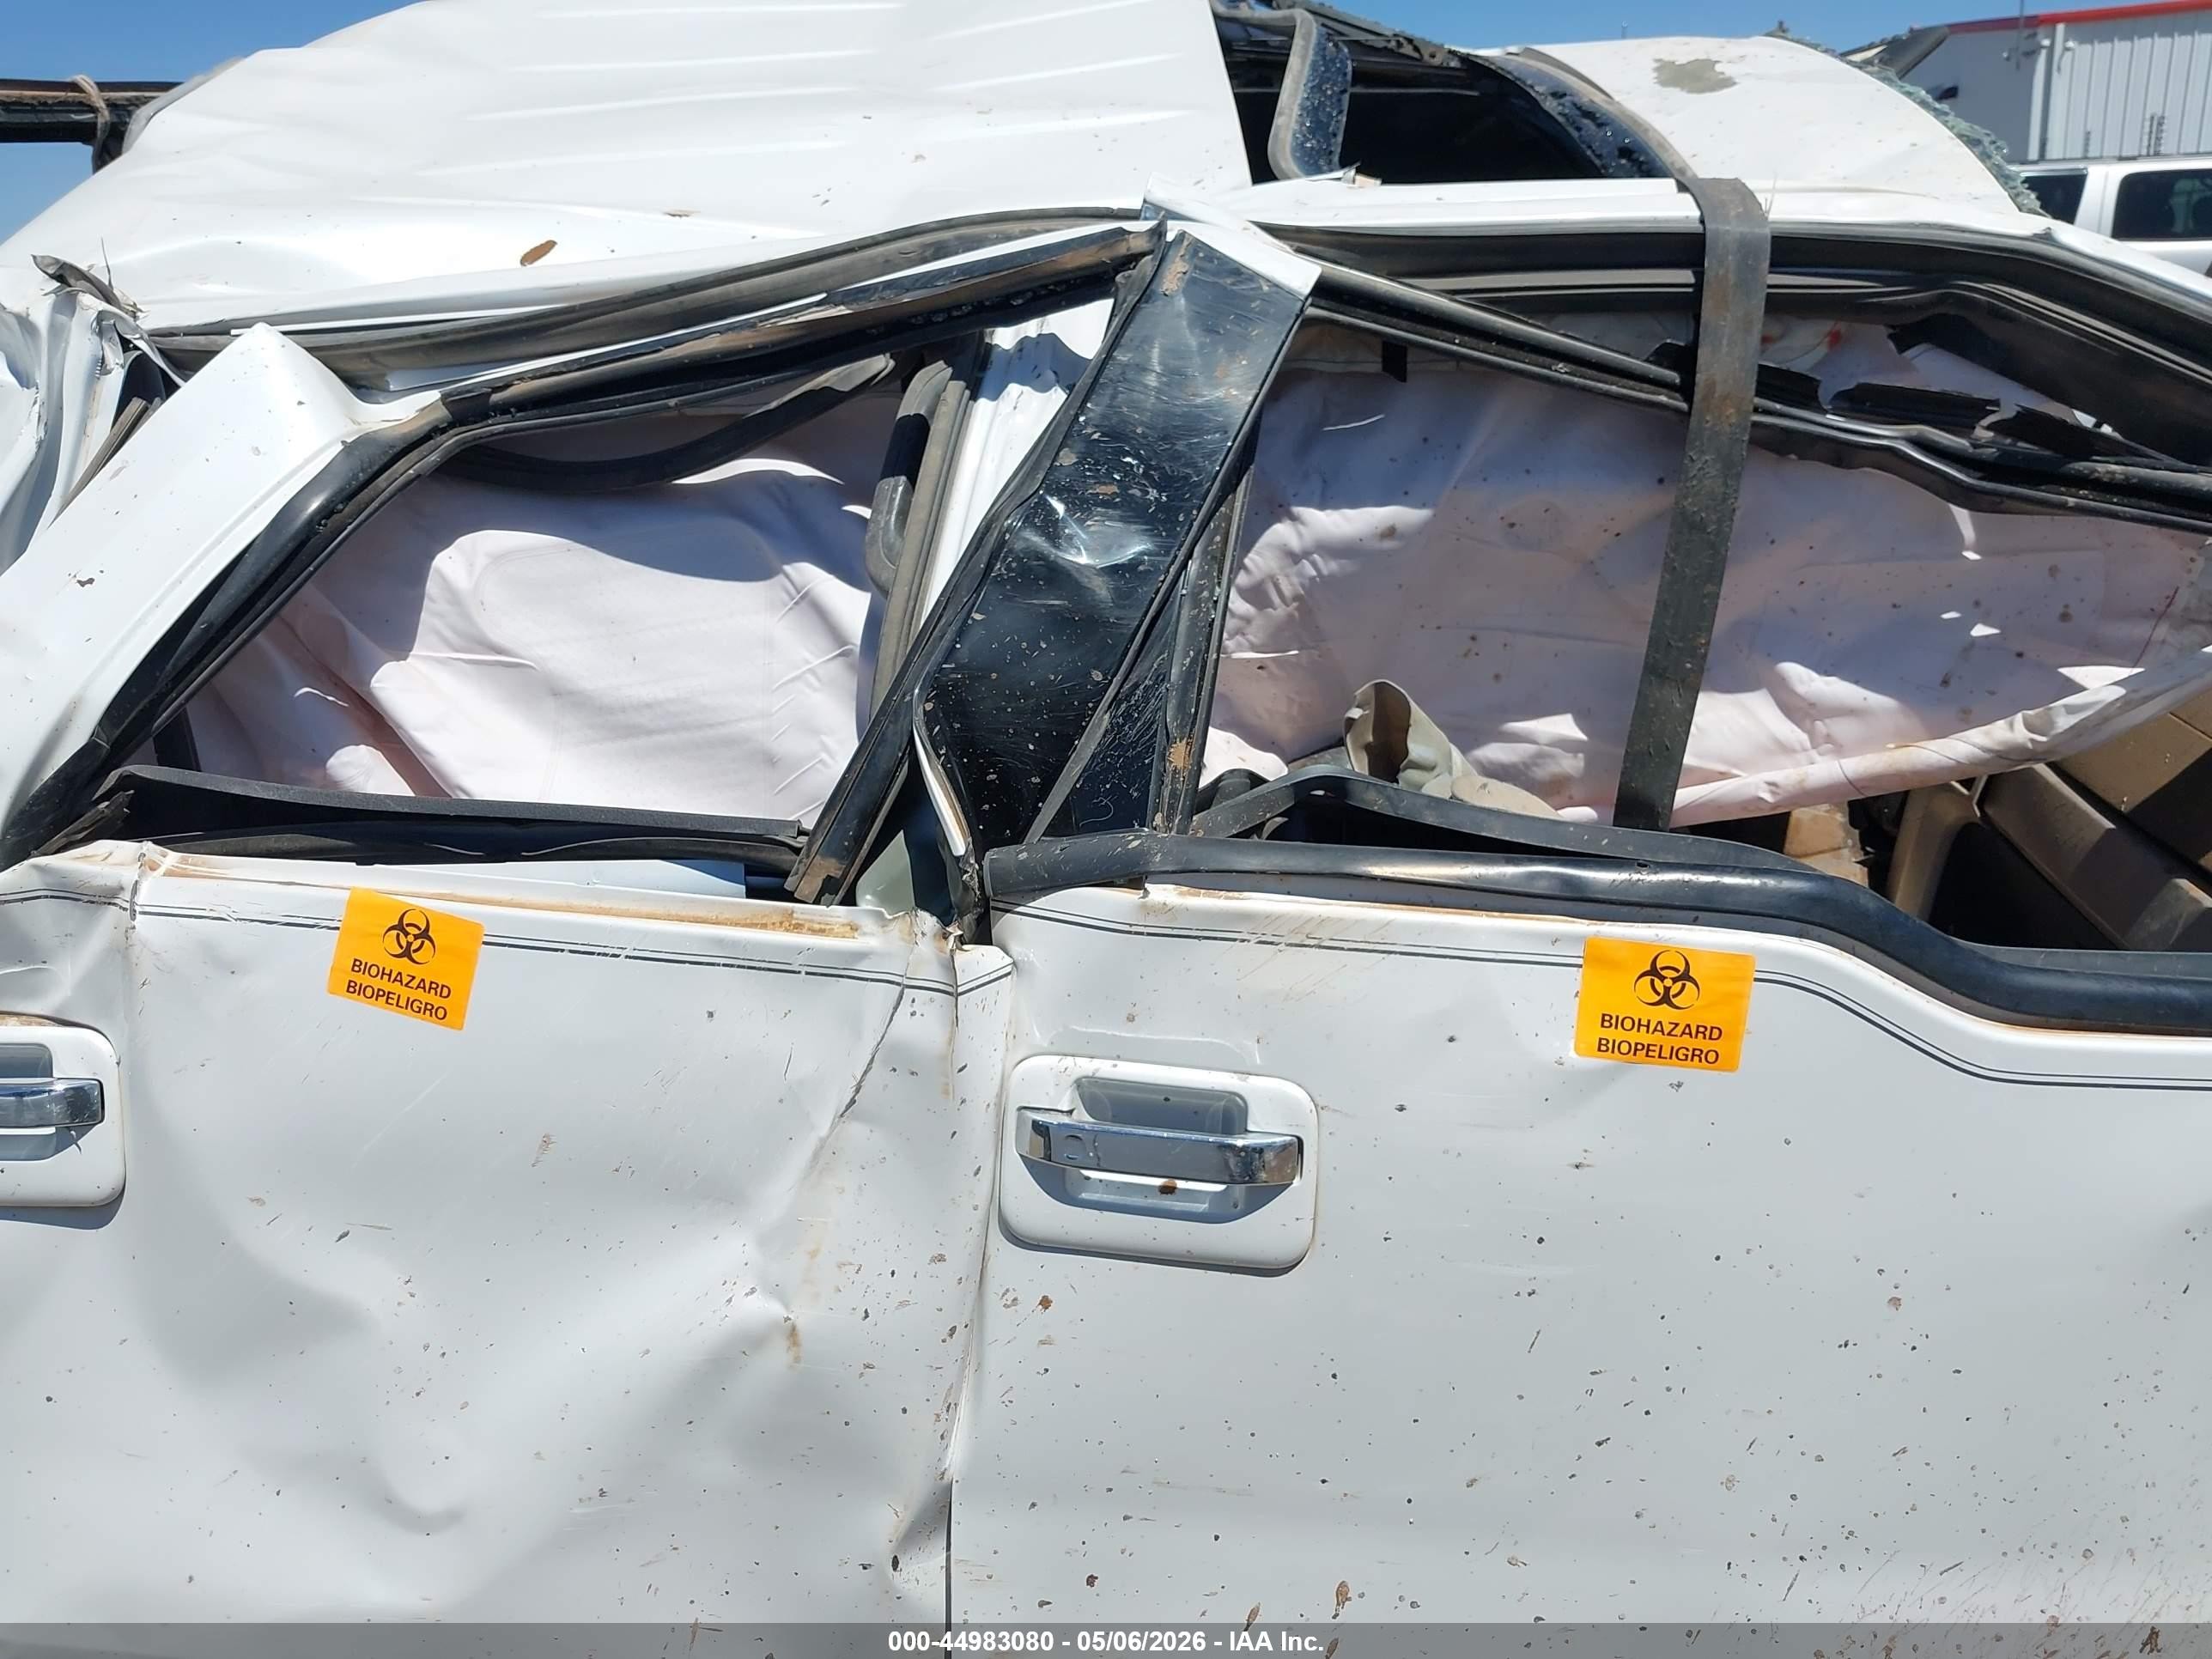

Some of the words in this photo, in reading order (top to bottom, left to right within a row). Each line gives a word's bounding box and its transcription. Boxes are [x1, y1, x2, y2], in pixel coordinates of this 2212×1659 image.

[350, 957, 452, 1000] BIOHAZARD
[345, 979, 448, 1021] BIOPELIGRO
[1600, 1012, 1723, 1042] BIOHAZARD
[1596, 1036, 1720, 1065] BIOPELIGRO
